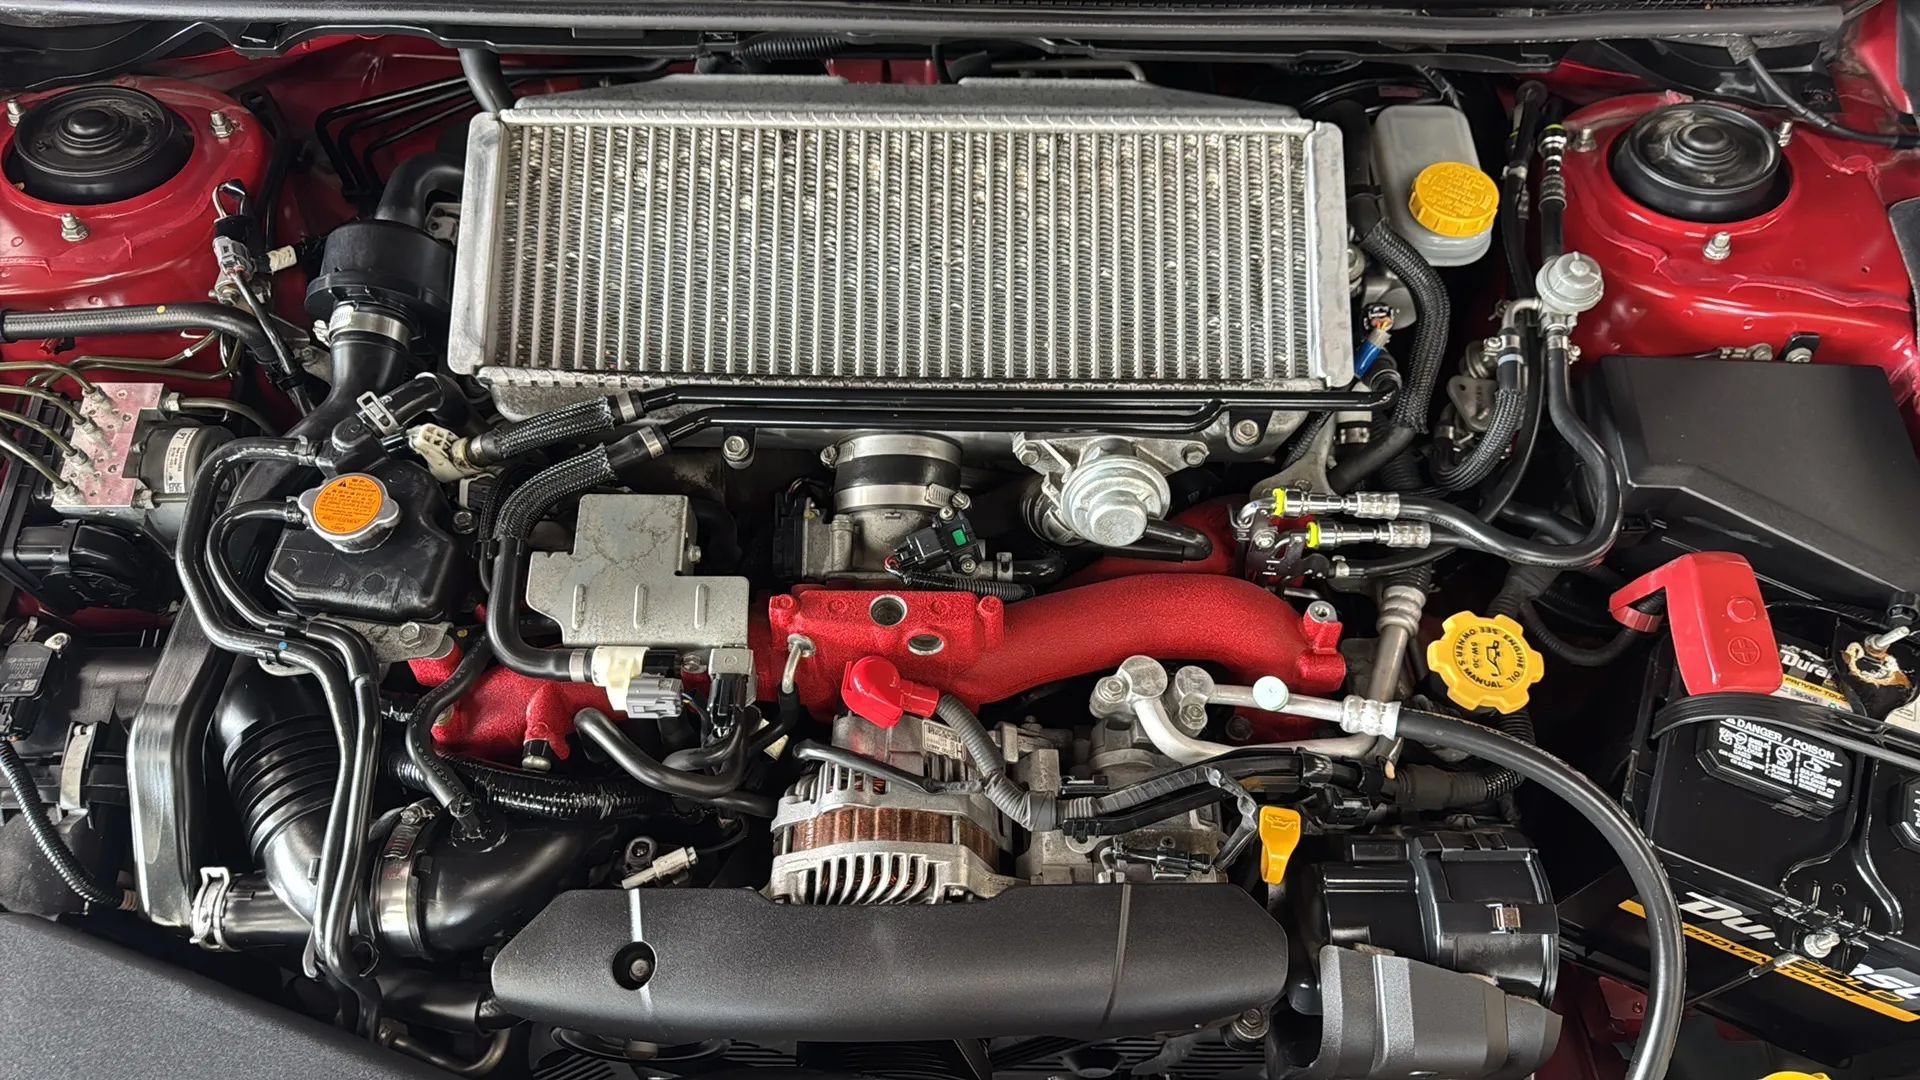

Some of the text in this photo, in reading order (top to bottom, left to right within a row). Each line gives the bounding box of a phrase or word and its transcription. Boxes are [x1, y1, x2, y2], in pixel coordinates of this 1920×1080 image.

[1478, 626, 1500, 636] SEE
[1470, 641, 1480, 670] 5W-30
[1502, 633, 1525, 684] ENGINE OIL
[1464, 667, 1505, 689] MANUAL
[1785, 676, 1821, 693] PROVEN
[1737, 718, 1783, 743] DANGER
[1793, 739, 1836, 761] POISON
[1780, 966, 1861, 998] TOUGH
